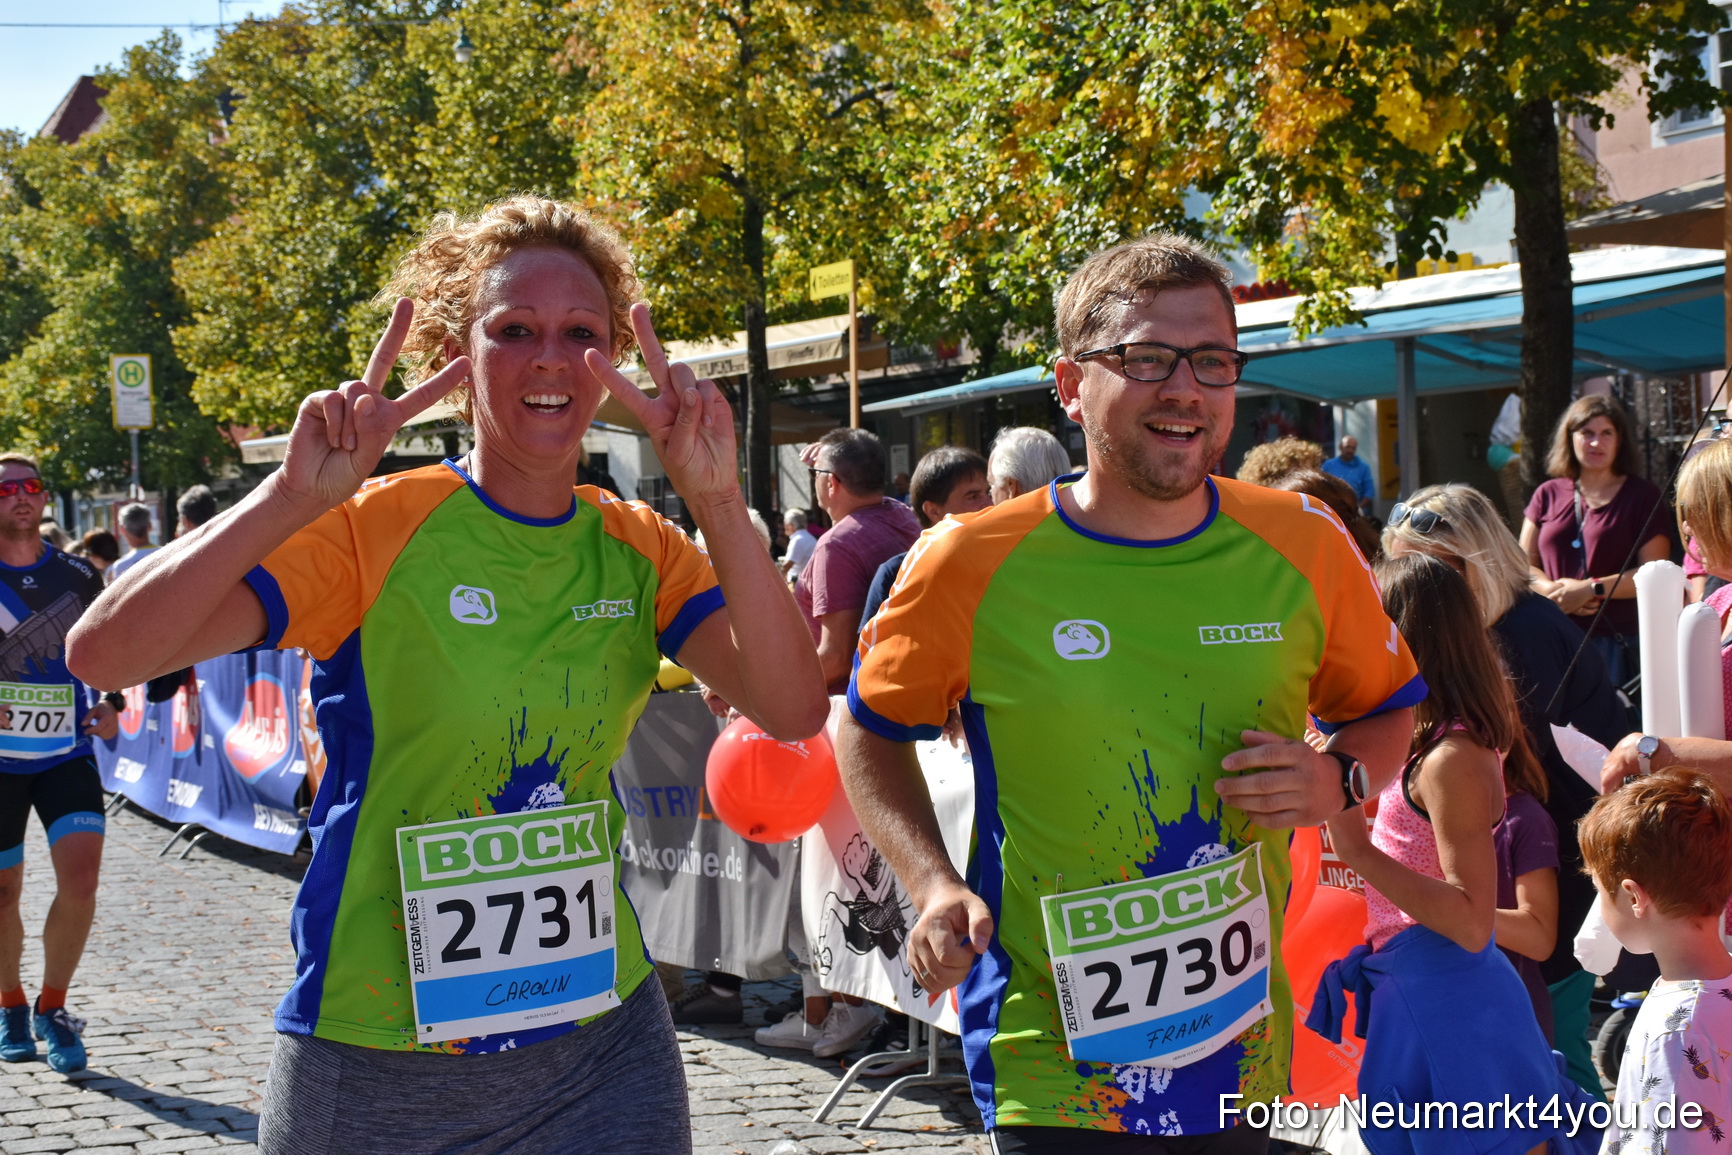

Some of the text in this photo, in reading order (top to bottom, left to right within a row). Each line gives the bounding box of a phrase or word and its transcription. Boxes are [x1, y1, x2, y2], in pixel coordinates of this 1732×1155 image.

[818, 272, 850, 289] Toiletten
[67, 558, 94, 580] GROH
[571, 598, 636, 621] BOCK
[1198, 622, 1284, 645] BOCK
[0, 685, 69, 705] BOCK
[416, 811, 602, 882] BOCK
[1061, 857, 1252, 947] BOCK
[435, 878, 597, 964] 2731
[1083, 919, 1253, 1021] 2730
[485, 973, 572, 1007] CAROLIN
[1146, 1012, 1214, 1050] FRANK
